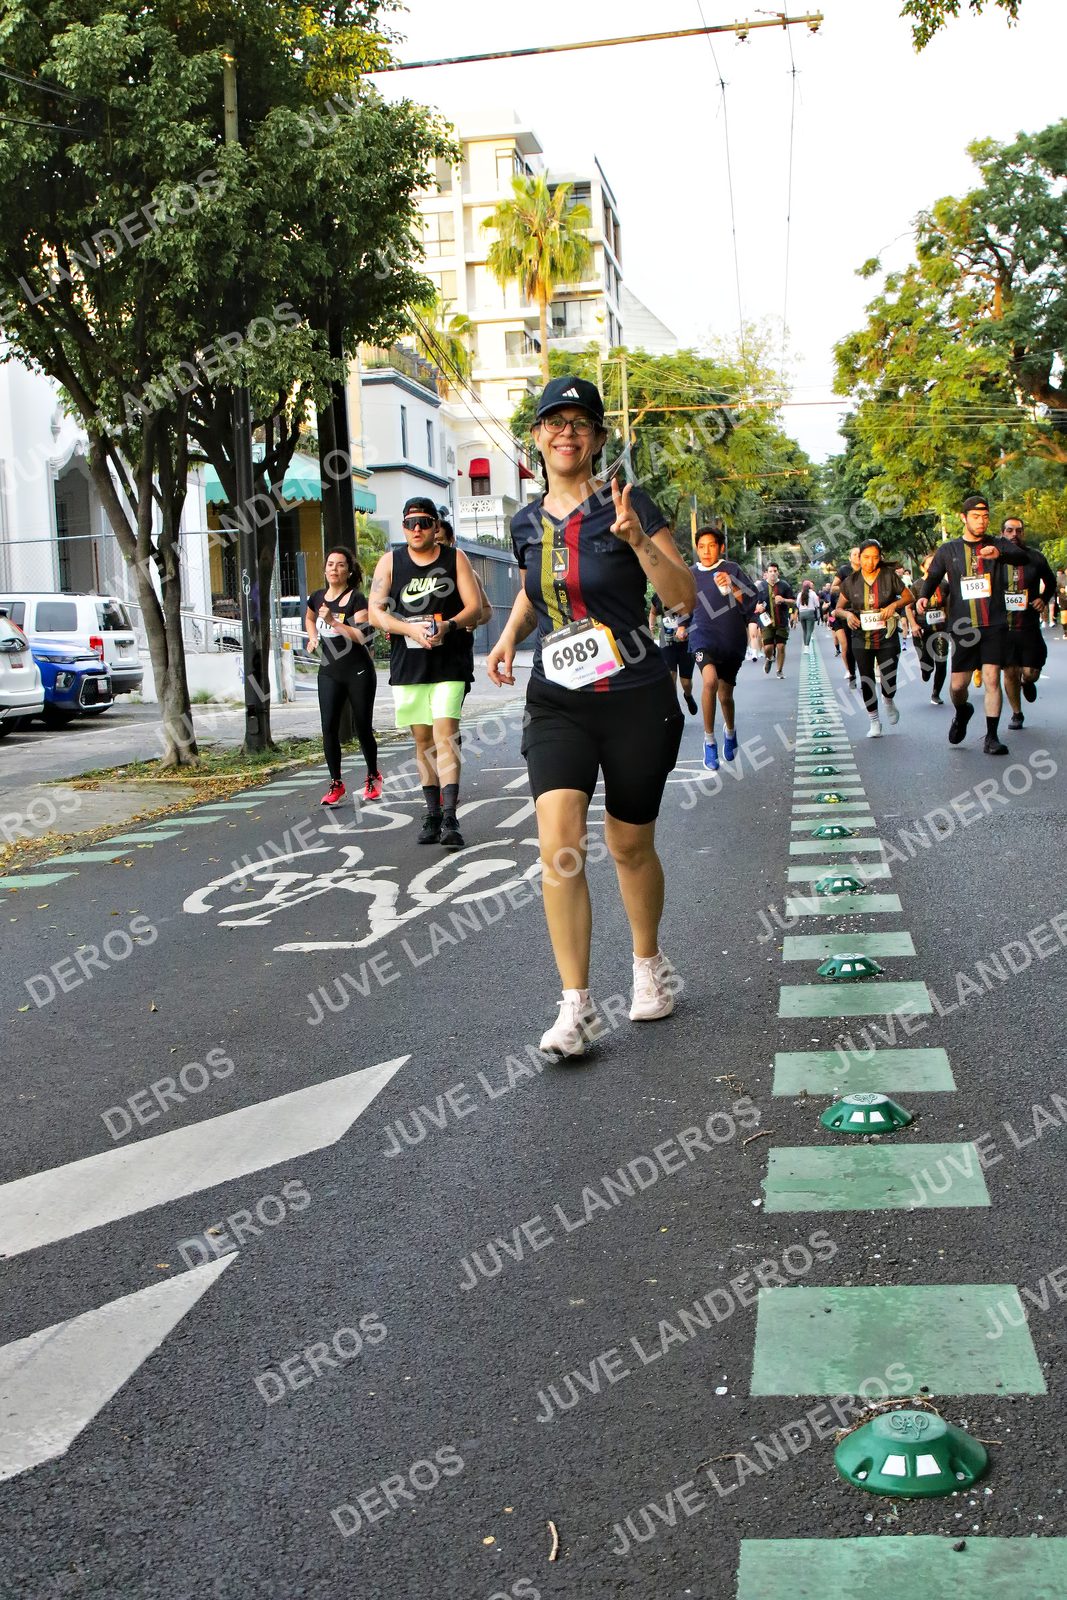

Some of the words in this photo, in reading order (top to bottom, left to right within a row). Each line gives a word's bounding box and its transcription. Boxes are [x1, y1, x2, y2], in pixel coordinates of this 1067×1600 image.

[408, 577, 438, 592] RUN
[966, 582, 985, 590] 1583
[552, 637, 599, 671] 6989
